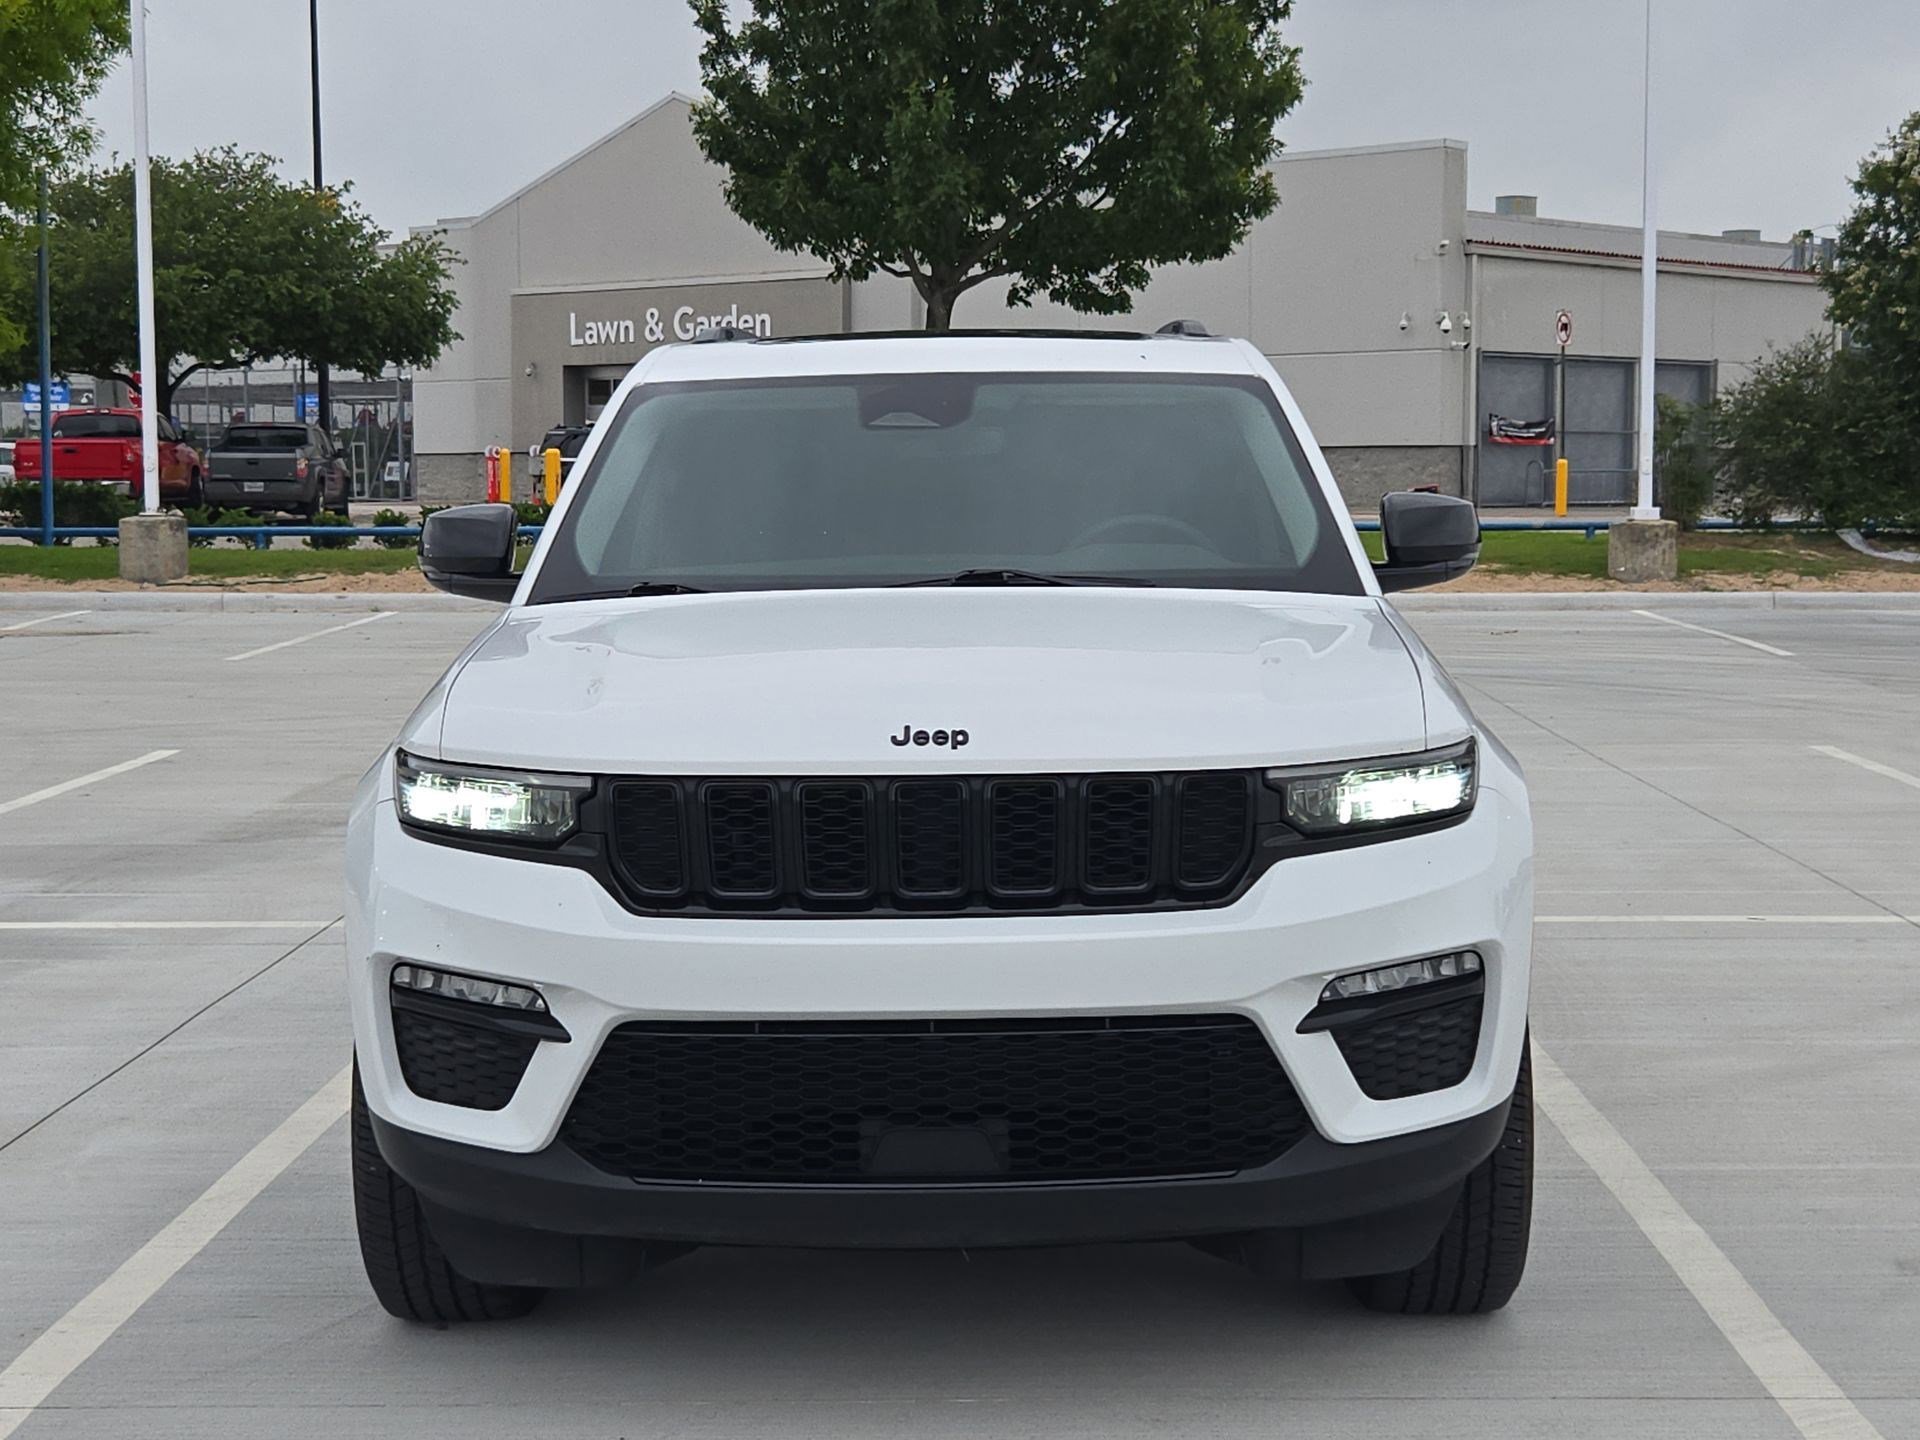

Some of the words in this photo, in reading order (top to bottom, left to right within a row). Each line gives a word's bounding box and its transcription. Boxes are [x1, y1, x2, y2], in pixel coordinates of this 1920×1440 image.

[569, 312, 635, 346] Lawn
[644, 307, 665, 342] &
[673, 304, 771, 342] Garden
[891, 725, 969, 749] Jeep
